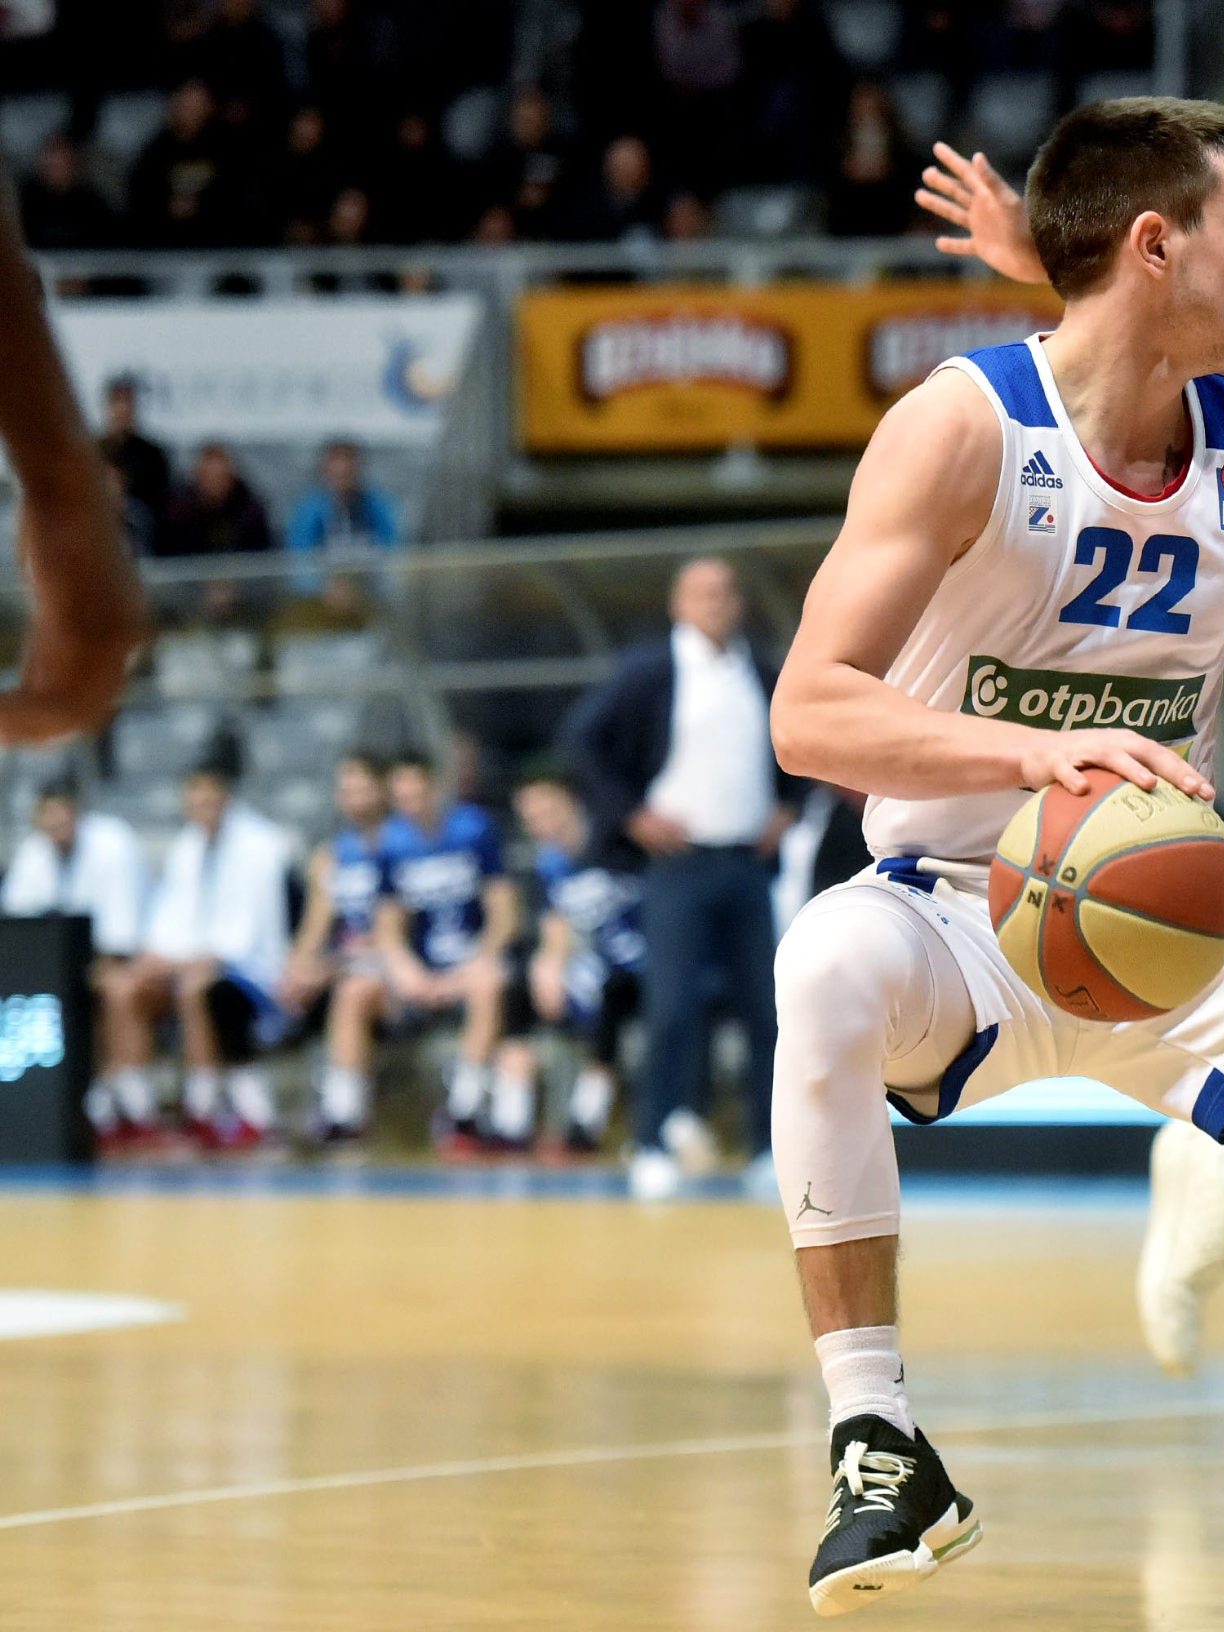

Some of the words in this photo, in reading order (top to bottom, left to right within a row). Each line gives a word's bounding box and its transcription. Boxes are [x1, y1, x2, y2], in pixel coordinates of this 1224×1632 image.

[1020, 473, 1064, 489] adidas
[1058, 526, 1200, 635] 22
[1018, 681, 1200, 732] otpbanka
